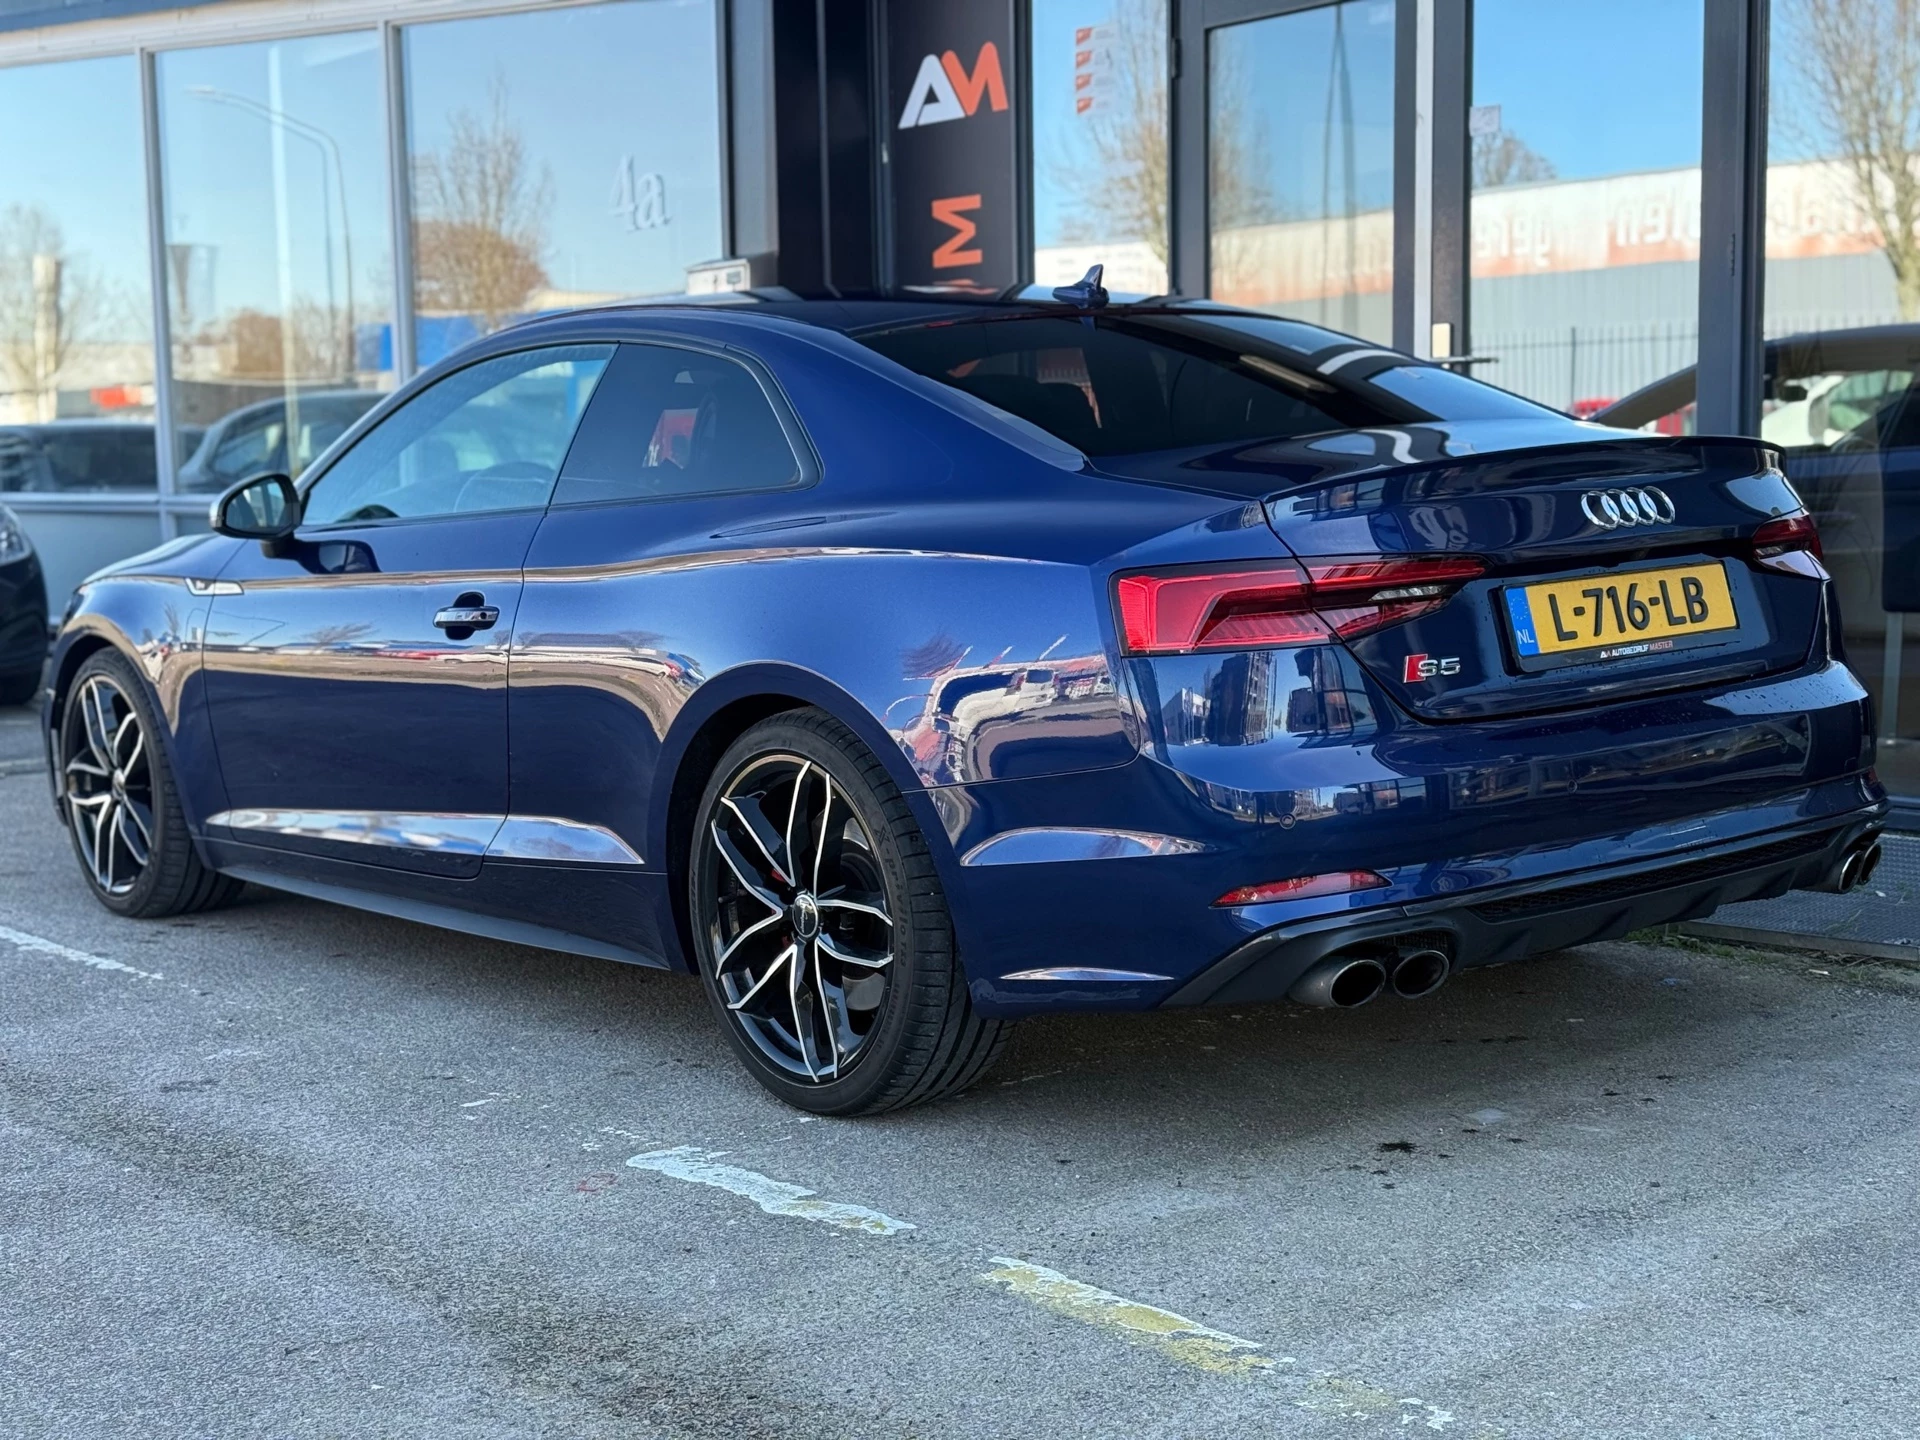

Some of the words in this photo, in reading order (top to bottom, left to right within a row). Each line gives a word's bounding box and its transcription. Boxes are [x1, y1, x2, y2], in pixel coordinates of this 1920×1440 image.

[898, 41, 1009, 130] AM
[607, 152, 673, 234] 4a
[1548, 576, 1709, 642] L-716-LB
[1516, 630, 1535, 645] NL
[1611, 644, 1649, 657] AUTOBEDRIJF
[1649, 640, 1674, 651] MASTER
[1417, 657, 1461, 677] S5
